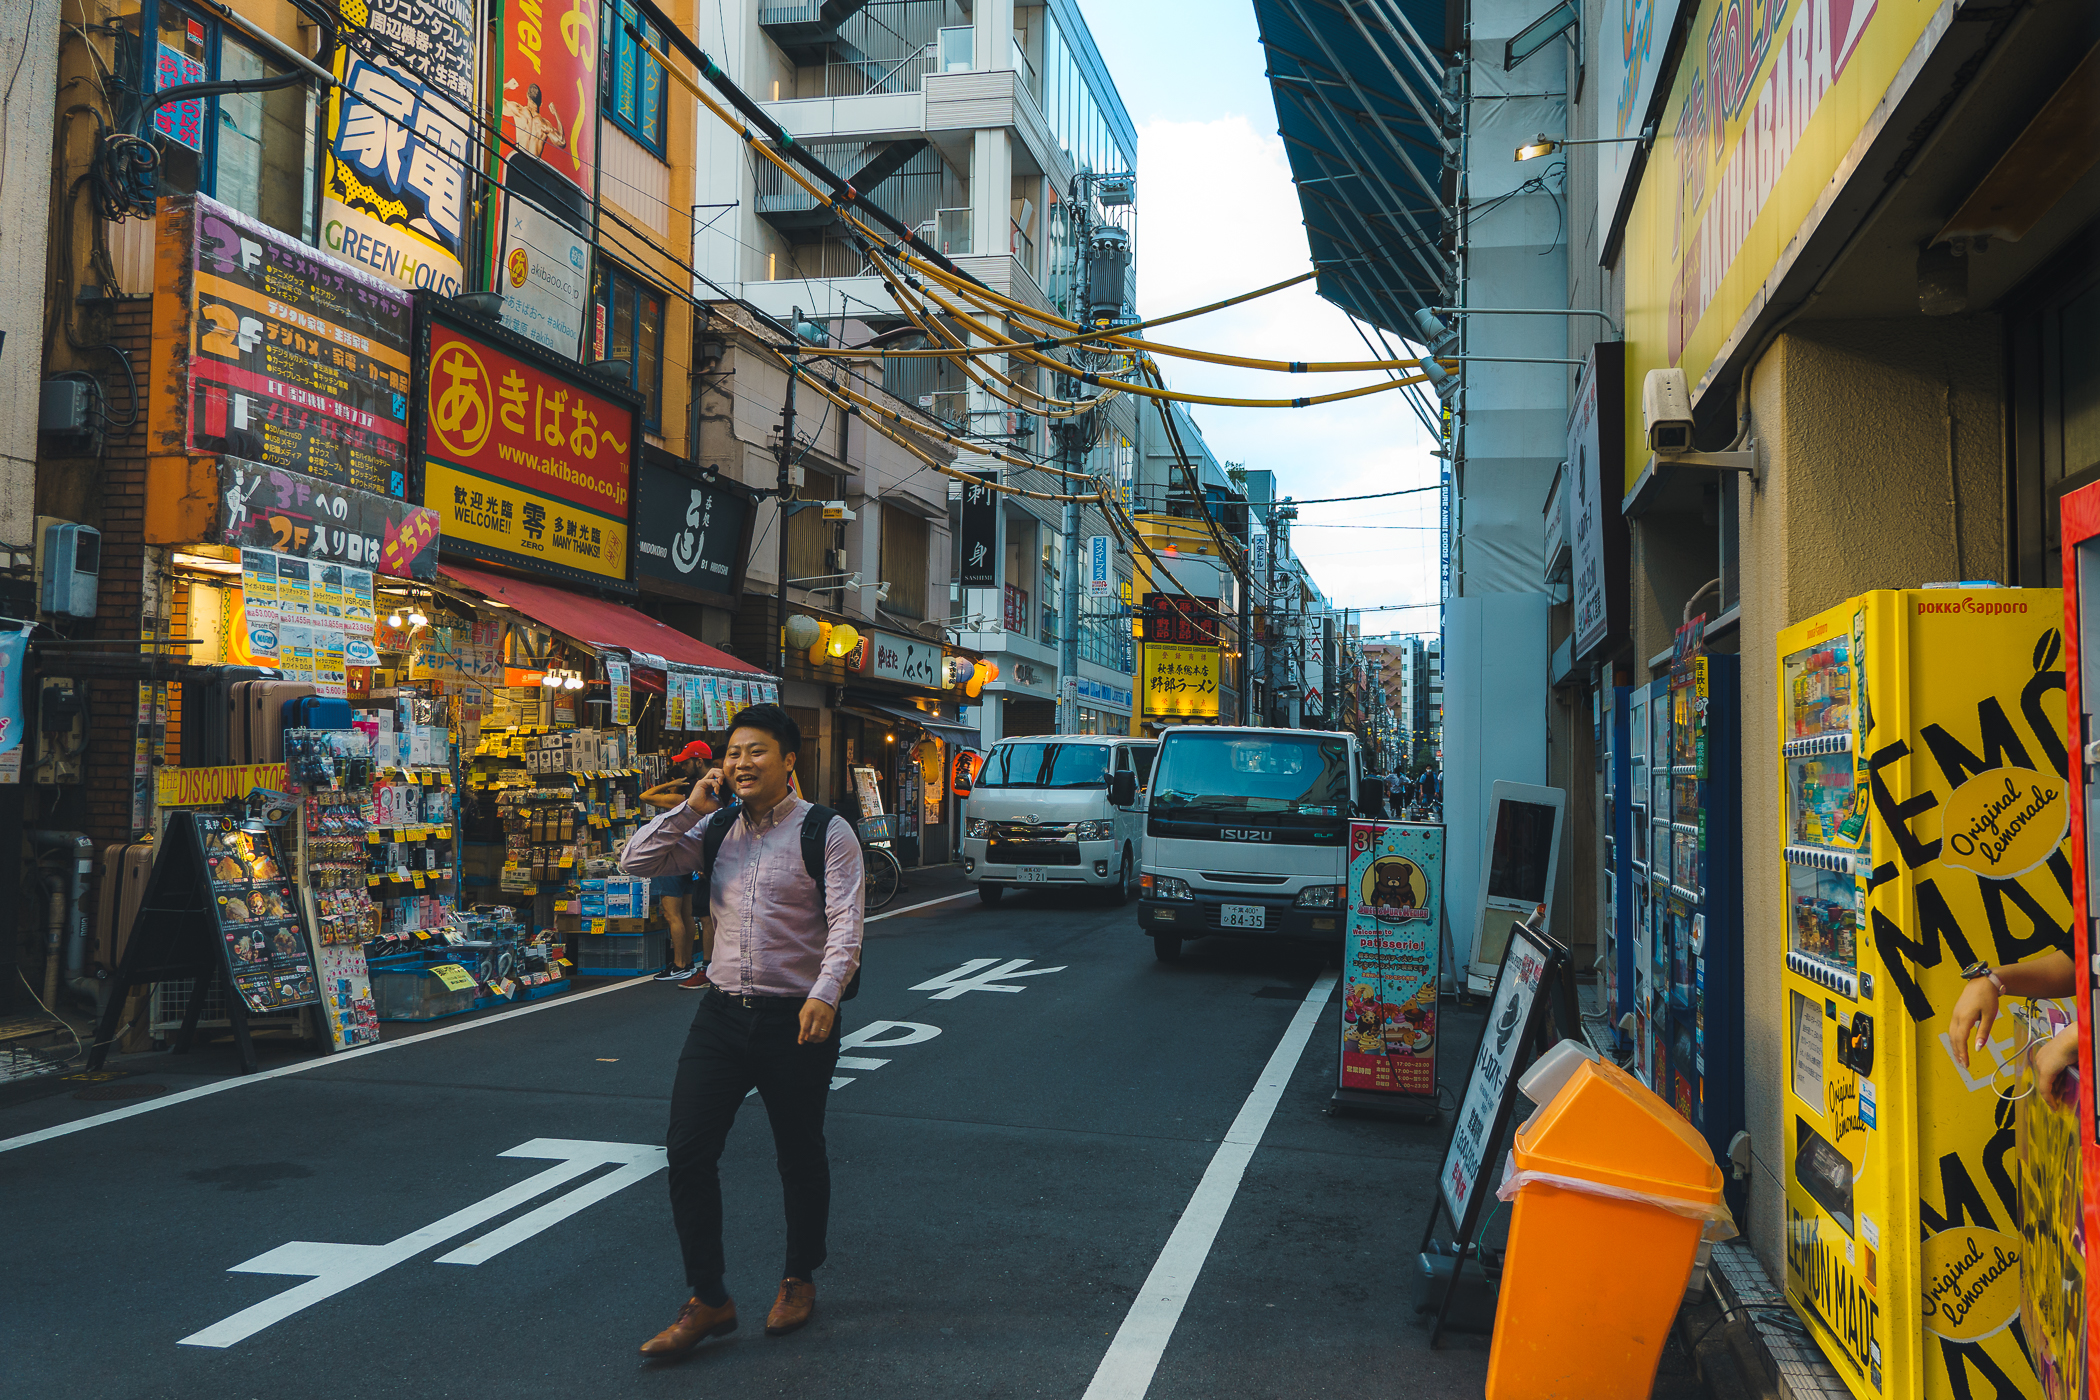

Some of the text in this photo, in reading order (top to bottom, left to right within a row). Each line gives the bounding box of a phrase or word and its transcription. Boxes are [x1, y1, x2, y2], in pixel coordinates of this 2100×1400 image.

[340, 66, 471, 238] 家電
[203, 216, 263, 275] 3F
[325, 219, 400, 277] GREEN
[530, 263, 580, 300] akibaoo.co.jp
[201, 303, 264, 361] 2F
[530, 330, 554, 349] #akiba
[547, 316, 577, 340] #akibaoo
[498, 443, 628, 505] www.akibaoo.co.jp
[453, 485, 514, 520] 歓迎光臨
[453, 505, 512, 535] WELCOME!!
[522, 501, 547, 541] 零
[385, 509, 433, 570] こちら
[520, 538, 545, 552] ZERO
[551, 533, 573, 551] MANY
[344, 596, 372, 608] VSR-ONE
[1150, 675, 1218, 694] 野郎ラーメン
[1157, 662, 1209, 676] 秋葉原総本店
[161, 766, 248, 805] THE DISCOUNT
[1220, 829, 1273, 841] ISUZU
[1950, 776, 2023, 858] Original
[1980, 784, 2060, 866] lemonade
[1353, 829, 1385, 853] 3F
[1230, 913, 1263, 927] 84-35
[1352, 928, 1384, 936] Welcome
[1359, 938, 1426, 951] patisserie!
[1828, 1071, 1856, 1115] Original
[1786, 1199, 1879, 1368] LEMON MADE
[1921, 1237, 1985, 1317] Original
